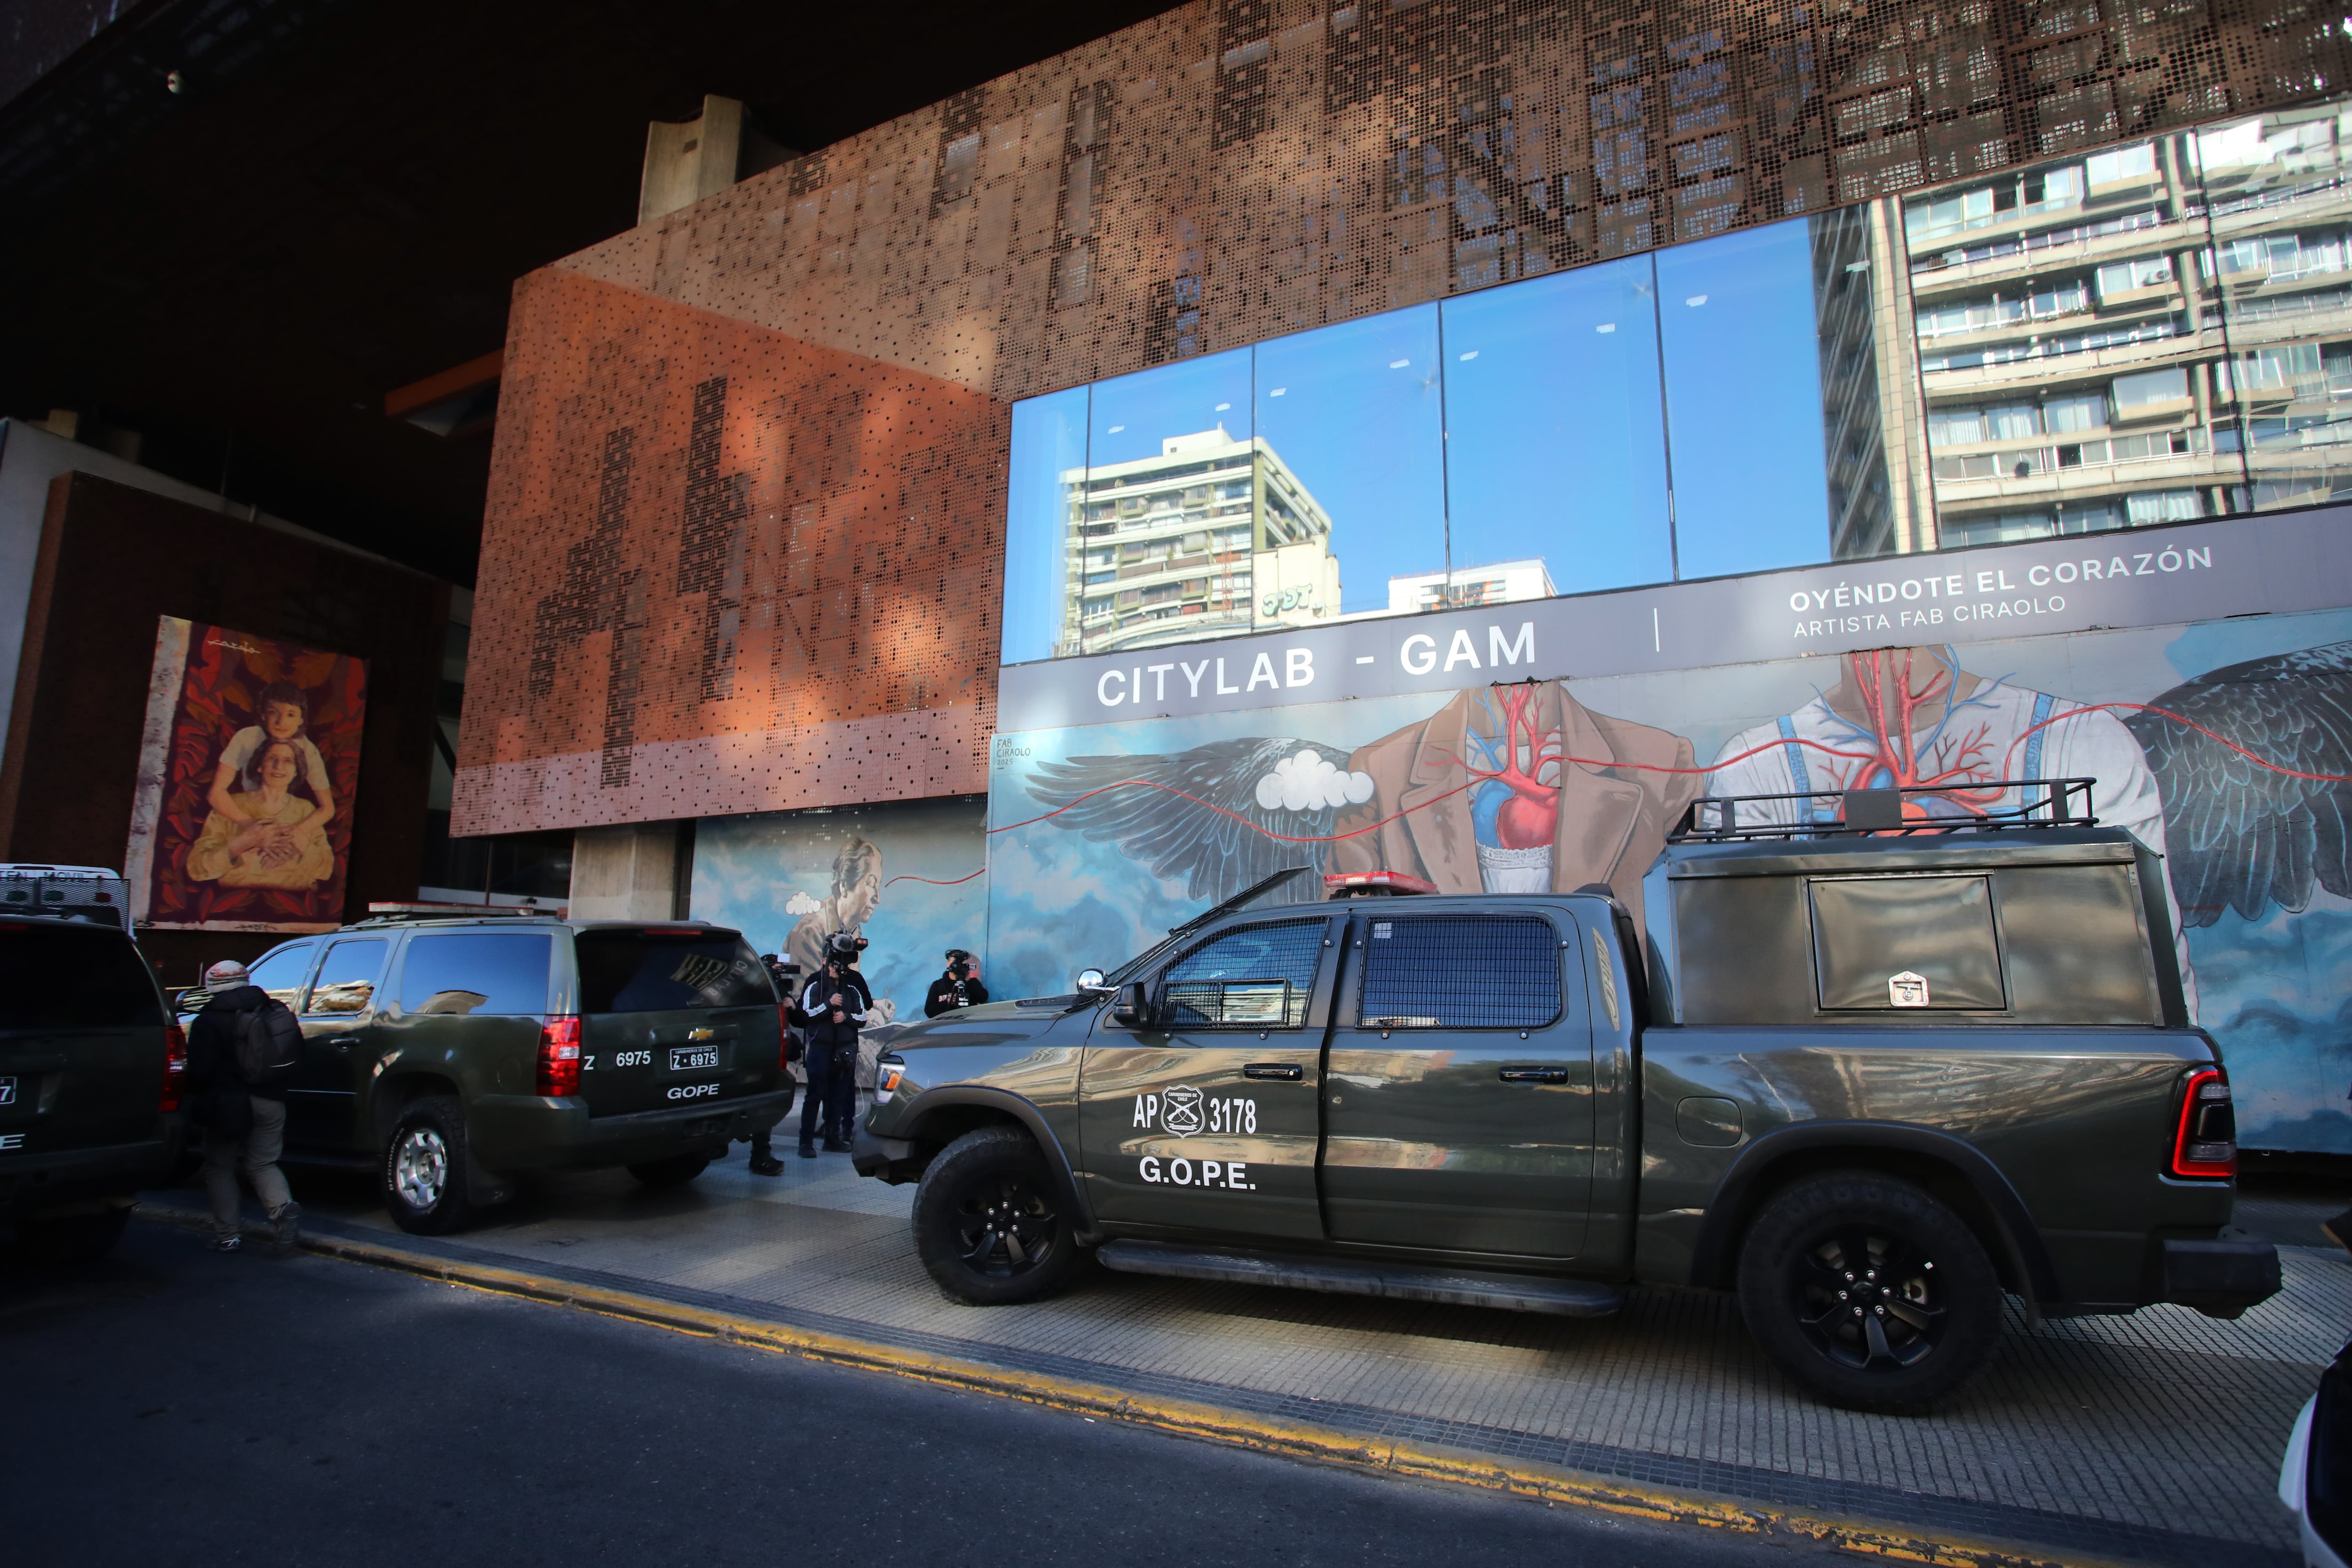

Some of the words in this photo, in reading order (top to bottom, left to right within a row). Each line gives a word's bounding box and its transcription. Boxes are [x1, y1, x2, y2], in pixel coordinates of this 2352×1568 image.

[1789, 573, 1964, 613] OYÉNDOTE
[1977, 569, 2016, 593] EL
[2028, 545, 2212, 586] CORAZÓN
[1793, 613, 1891, 639] ARTISTA
[1900, 608, 1944, 627] FAB
[1953, 595, 2066, 622] CIRAOLO
[1097, 648, 1315, 707] CITYLAB
[1400, 621, 1535, 675] GAM
[996, 748, 1031, 758] CIRAOLO
[997, 738, 1012, 749] FAB
[584, 1055, 595, 1070] Z
[616, 1050, 651, 1067] 6975
[673, 1055, 680, 1068] Z
[691, 1052, 716, 1066] 6975
[667, 1083, 720, 1100] GOPE
[1133, 1094, 1158, 1128] AP
[1209, 1097, 1257, 1134] 3178
[1139, 1156, 1256, 1190] G.O.P.E.
